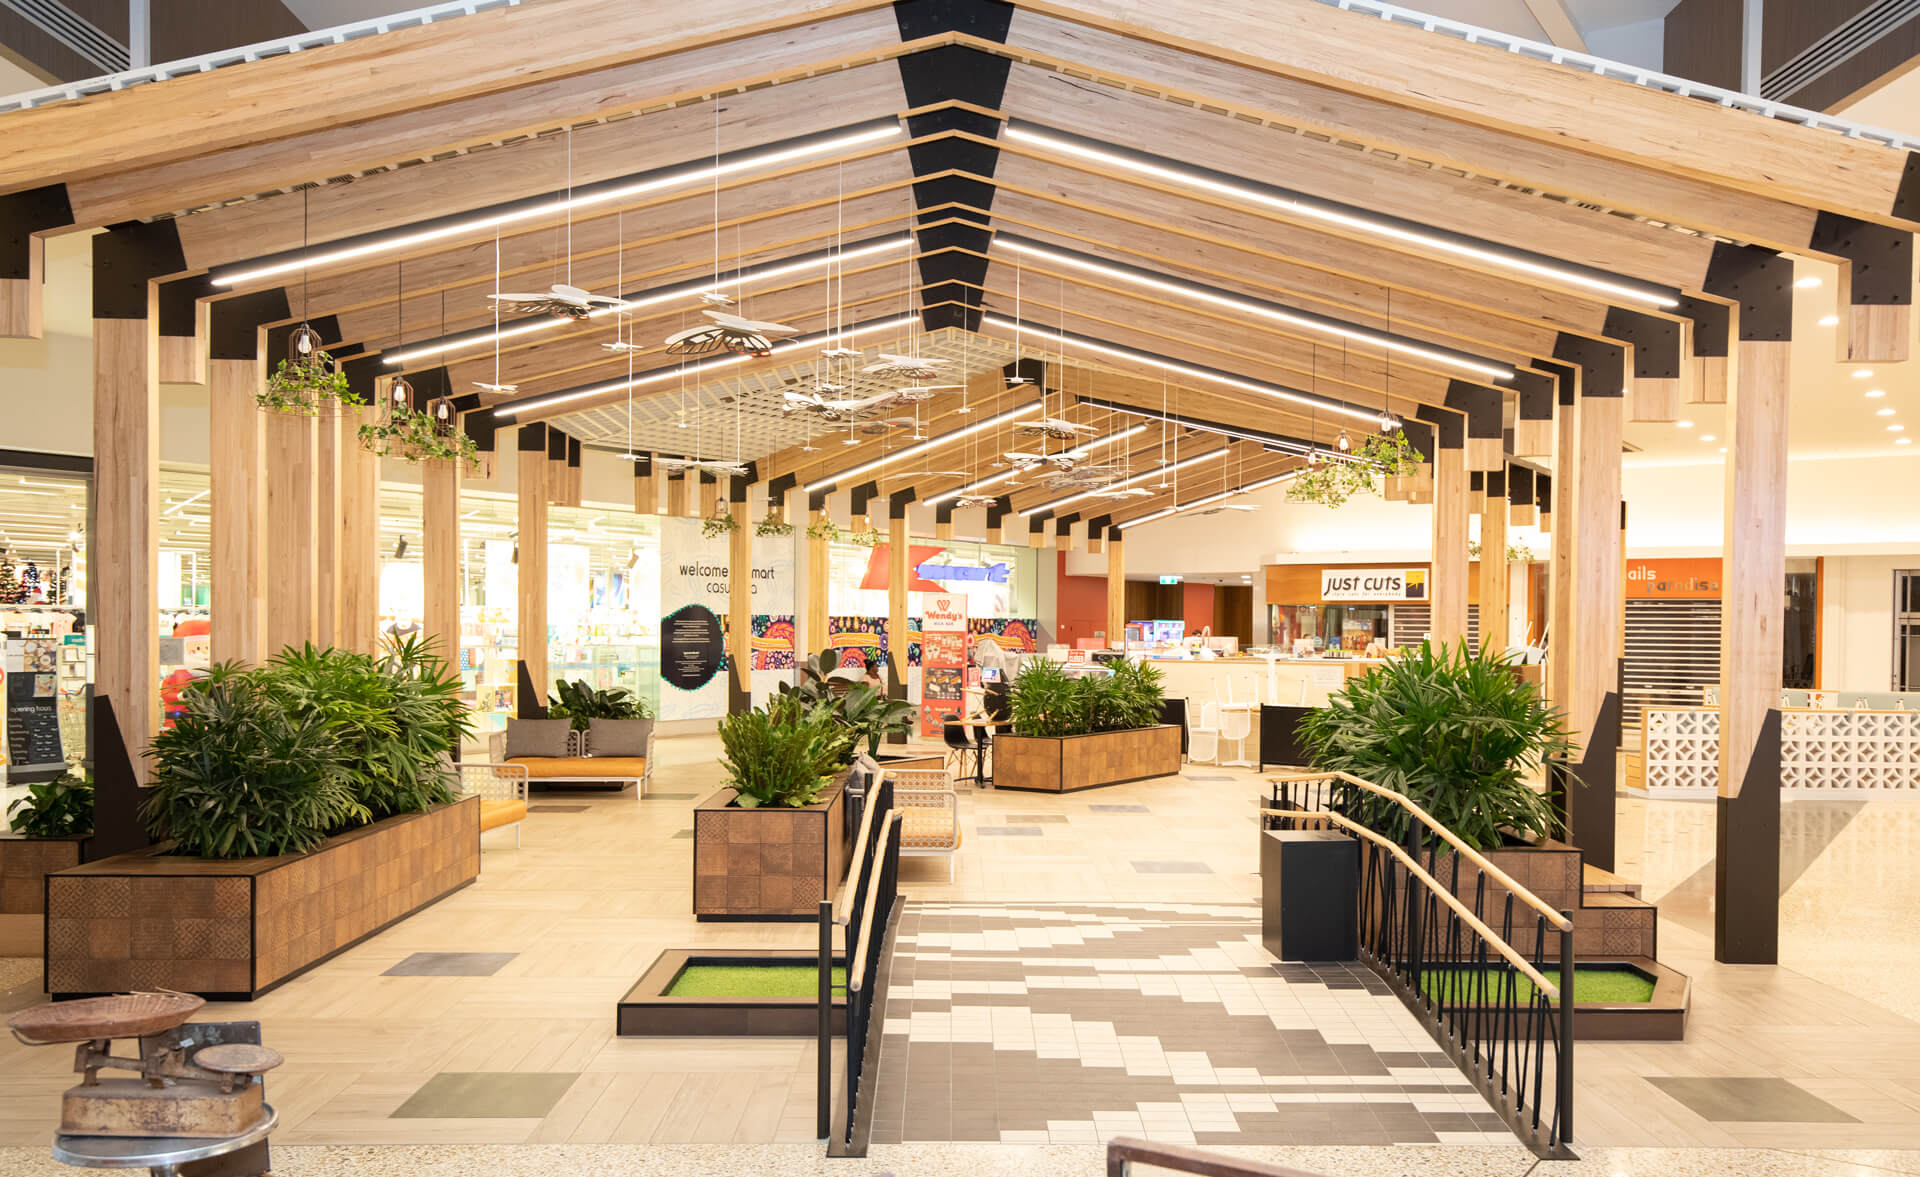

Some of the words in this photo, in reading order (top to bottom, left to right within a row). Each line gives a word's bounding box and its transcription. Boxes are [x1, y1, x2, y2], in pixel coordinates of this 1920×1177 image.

[679, 561, 729, 578] welcome
[751, 566, 775, 580] mart
[1627, 565, 1657, 581] ails
[1647, 577, 1719, 596] paradise
[925, 610, 963, 622] Wendy's
